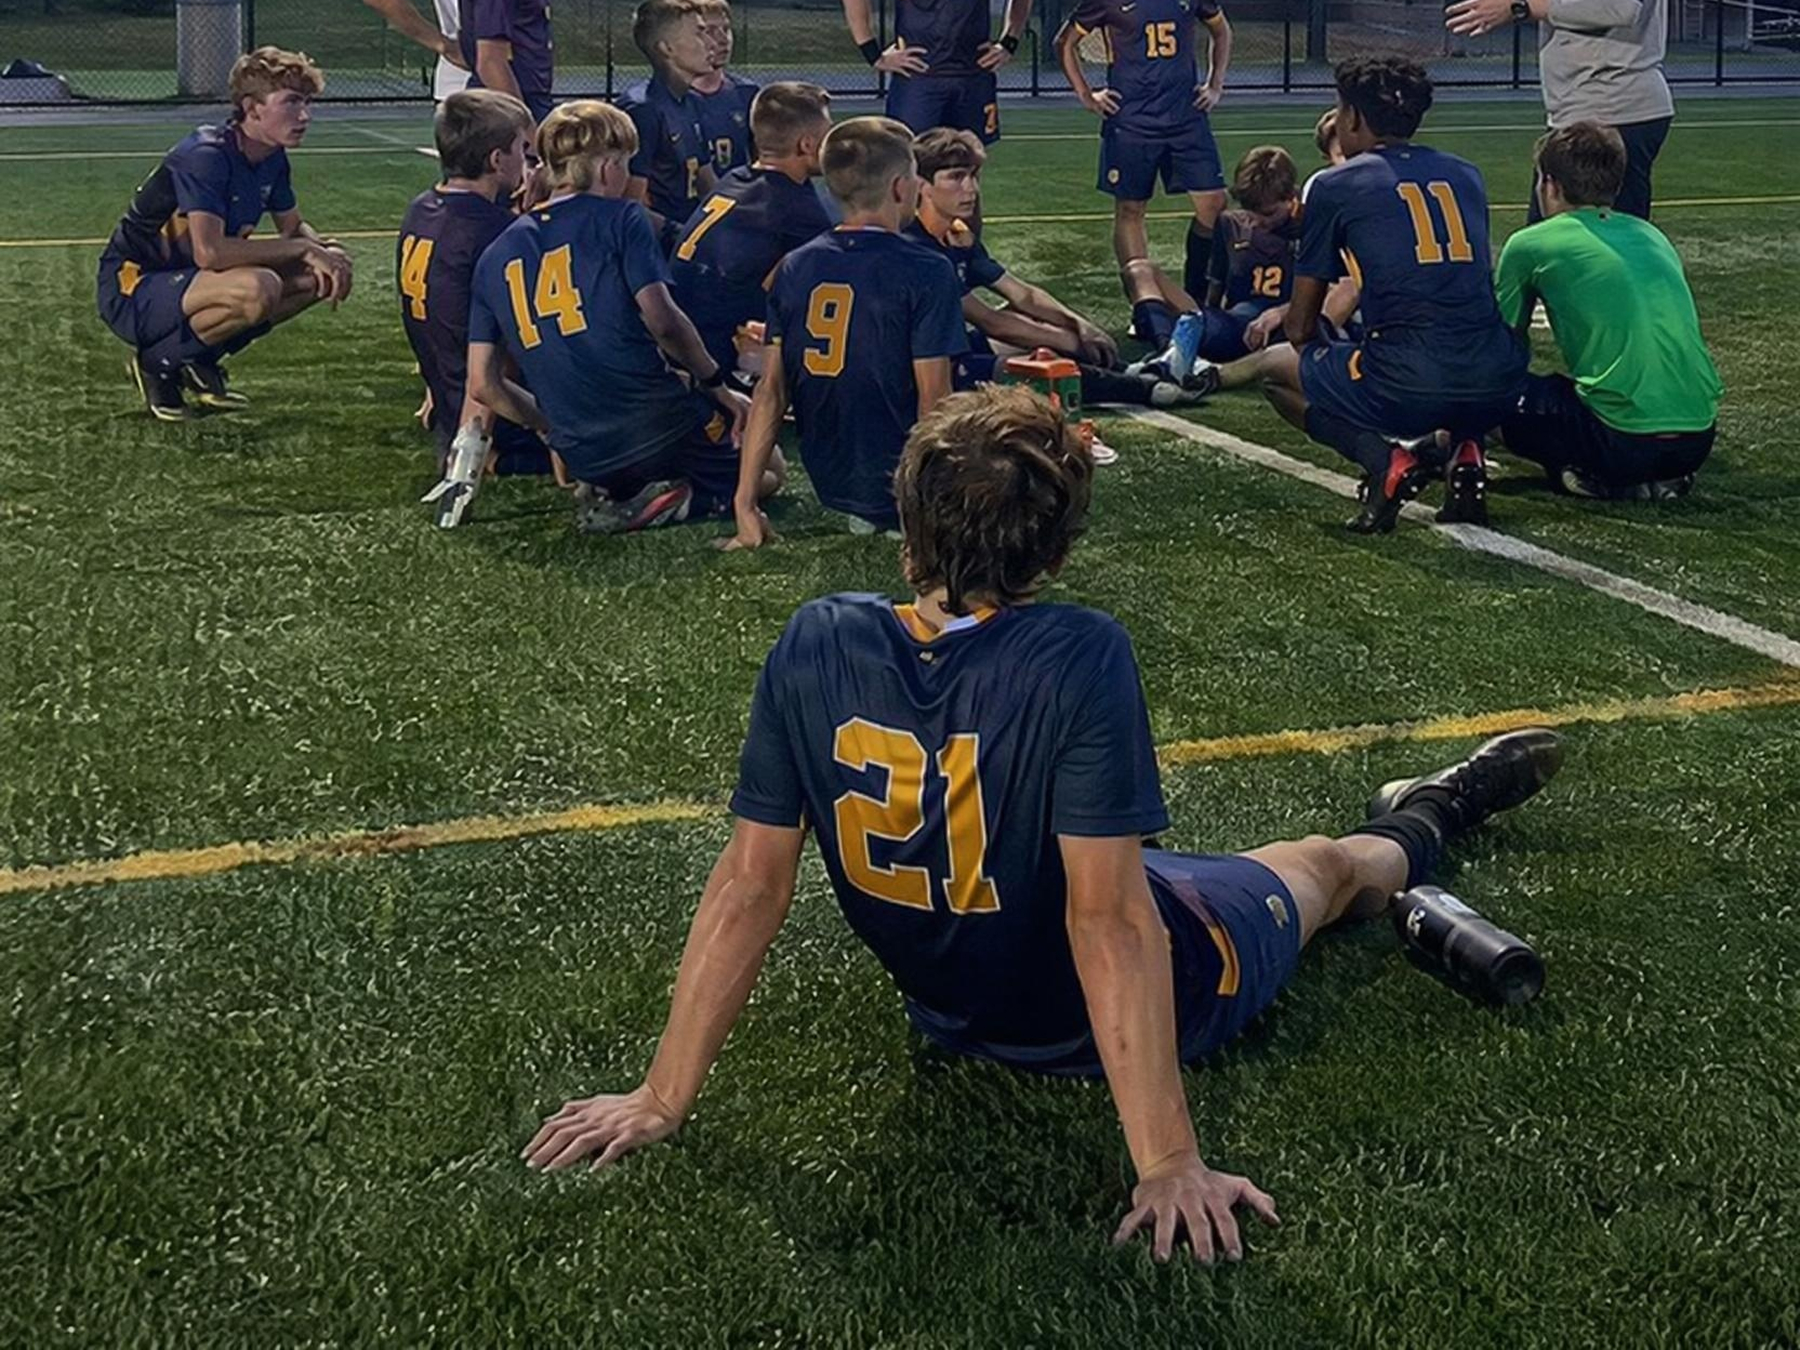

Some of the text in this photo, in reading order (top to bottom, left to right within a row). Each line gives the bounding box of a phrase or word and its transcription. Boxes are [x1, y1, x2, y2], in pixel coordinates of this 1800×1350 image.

[1144, 21, 1177, 58] 15
[676, 195, 736, 261] 7
[1397, 181, 1473, 263] 11
[504, 243, 588, 350] 14
[1252, 265, 1283, 298] 12
[803, 282, 855, 378] 9
[833, 716, 1001, 915] 21
